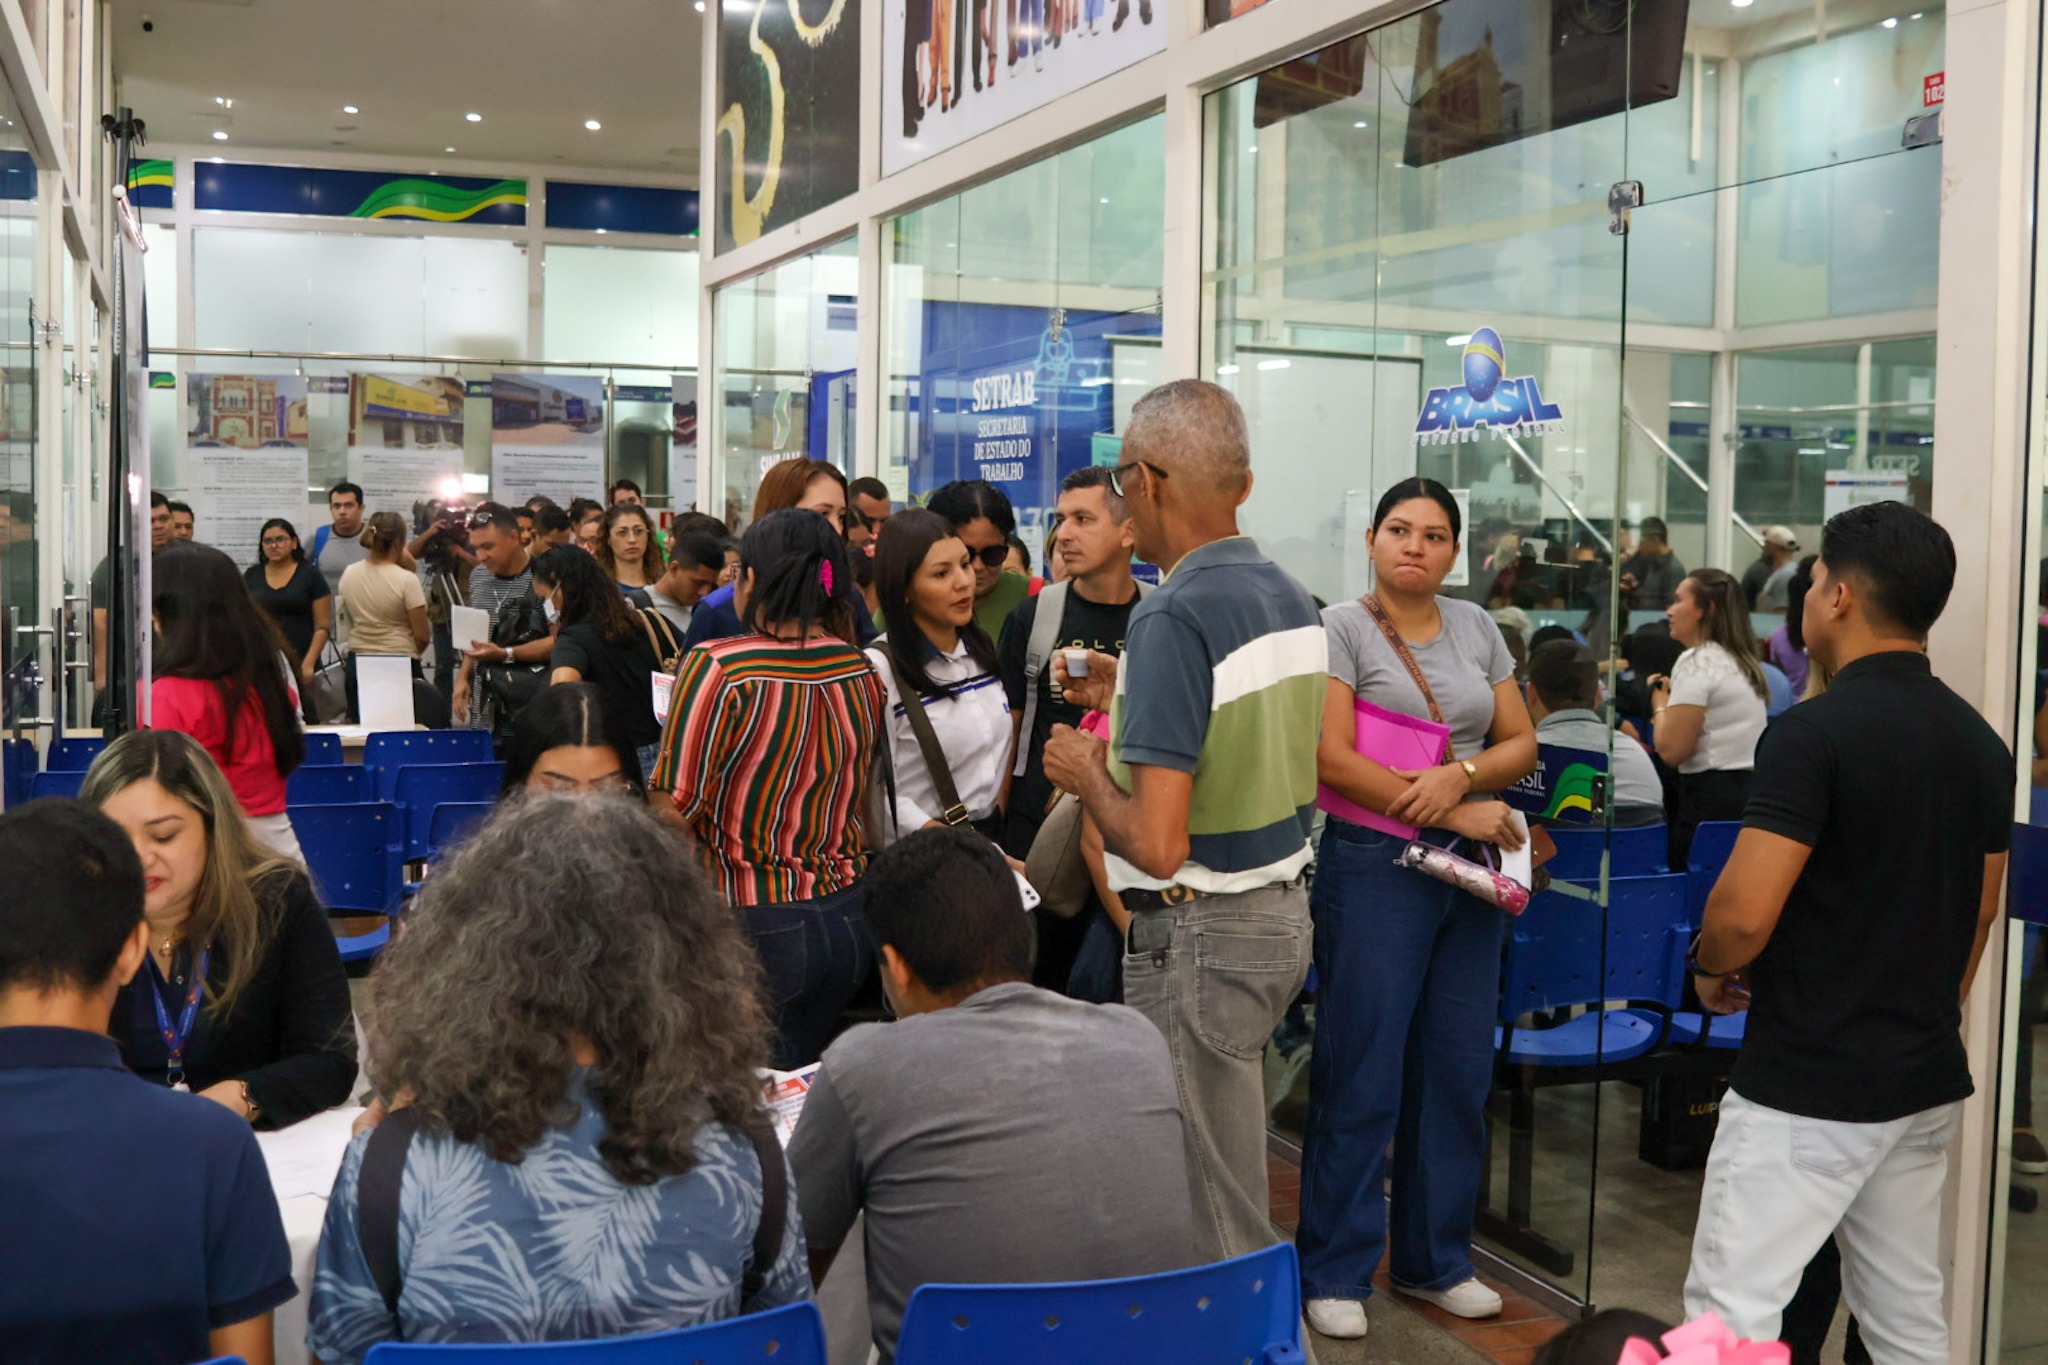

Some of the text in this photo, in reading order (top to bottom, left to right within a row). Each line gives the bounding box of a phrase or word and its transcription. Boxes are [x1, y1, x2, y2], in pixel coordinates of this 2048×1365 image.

[972, 370, 1035, 413] SETRAB
[1415, 375, 1563, 433] BRASIL
[978, 416, 1027, 438] SECRETARIA
[1411, 429, 1480, 447] GOVERNO
[974, 438, 1031, 460] DE ESTADO DO
[981, 462, 1024, 482] TRABALHO
